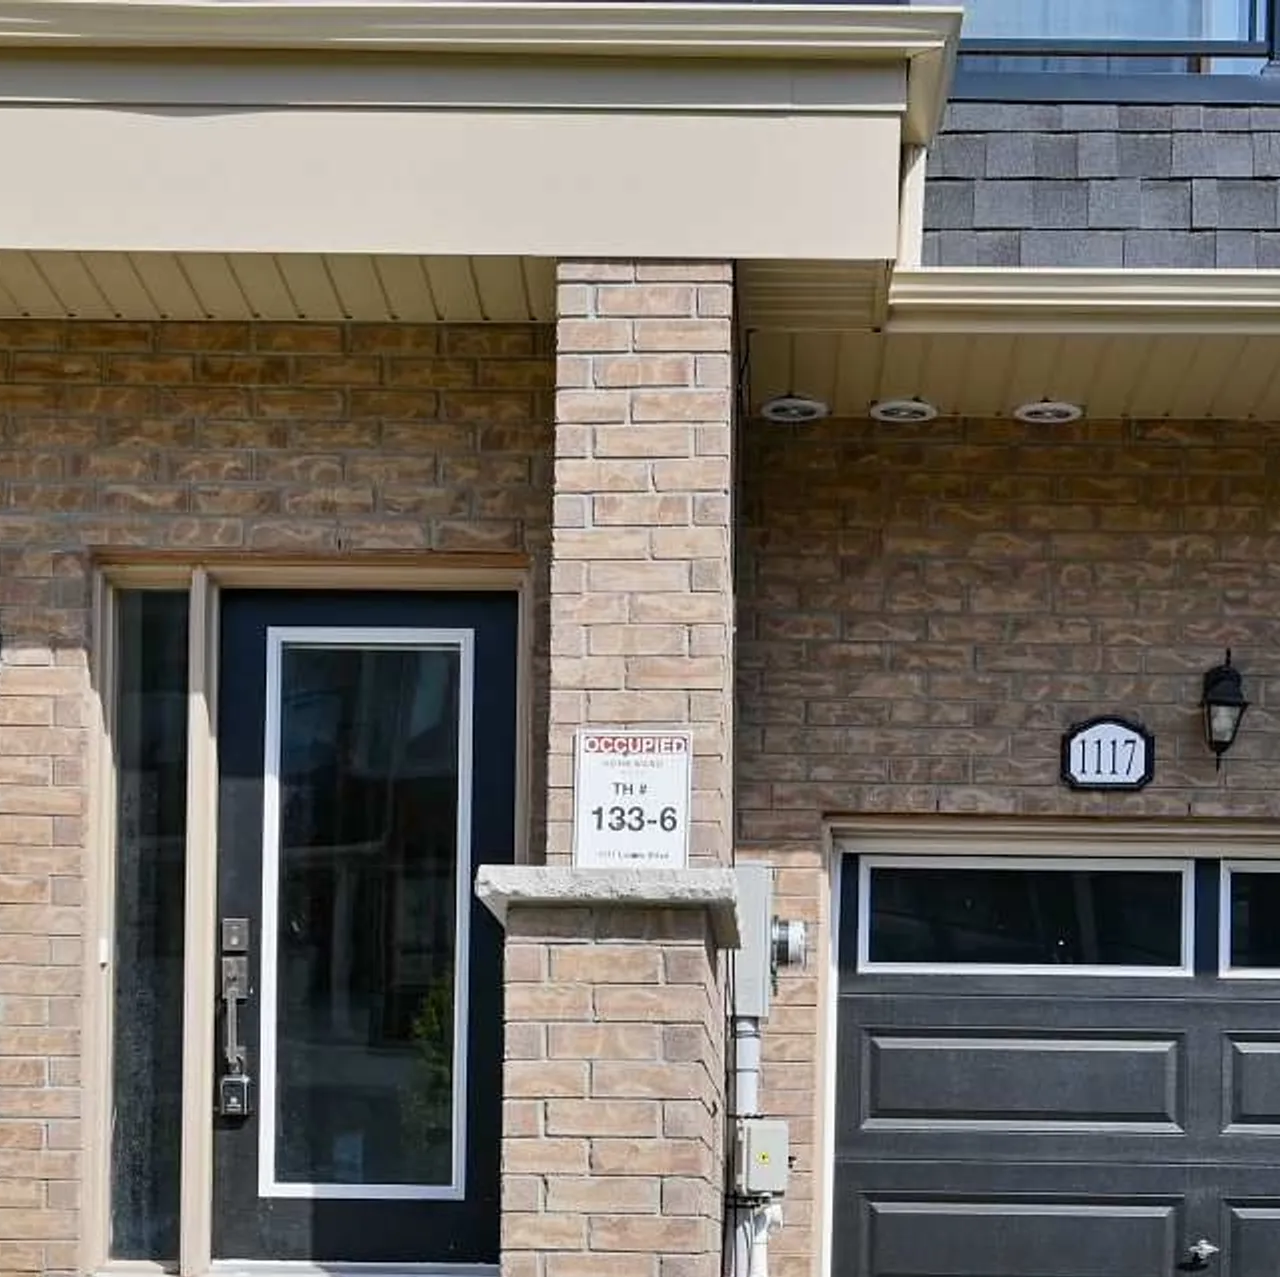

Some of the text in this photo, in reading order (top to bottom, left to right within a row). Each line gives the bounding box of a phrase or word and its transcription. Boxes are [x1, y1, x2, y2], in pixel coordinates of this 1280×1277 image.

[585, 737, 687, 753] OCCUPIED
[1081, 739, 1137, 775] 1117
[612, 782, 633, 795] TH
[592, 806, 677, 831] 133-6
